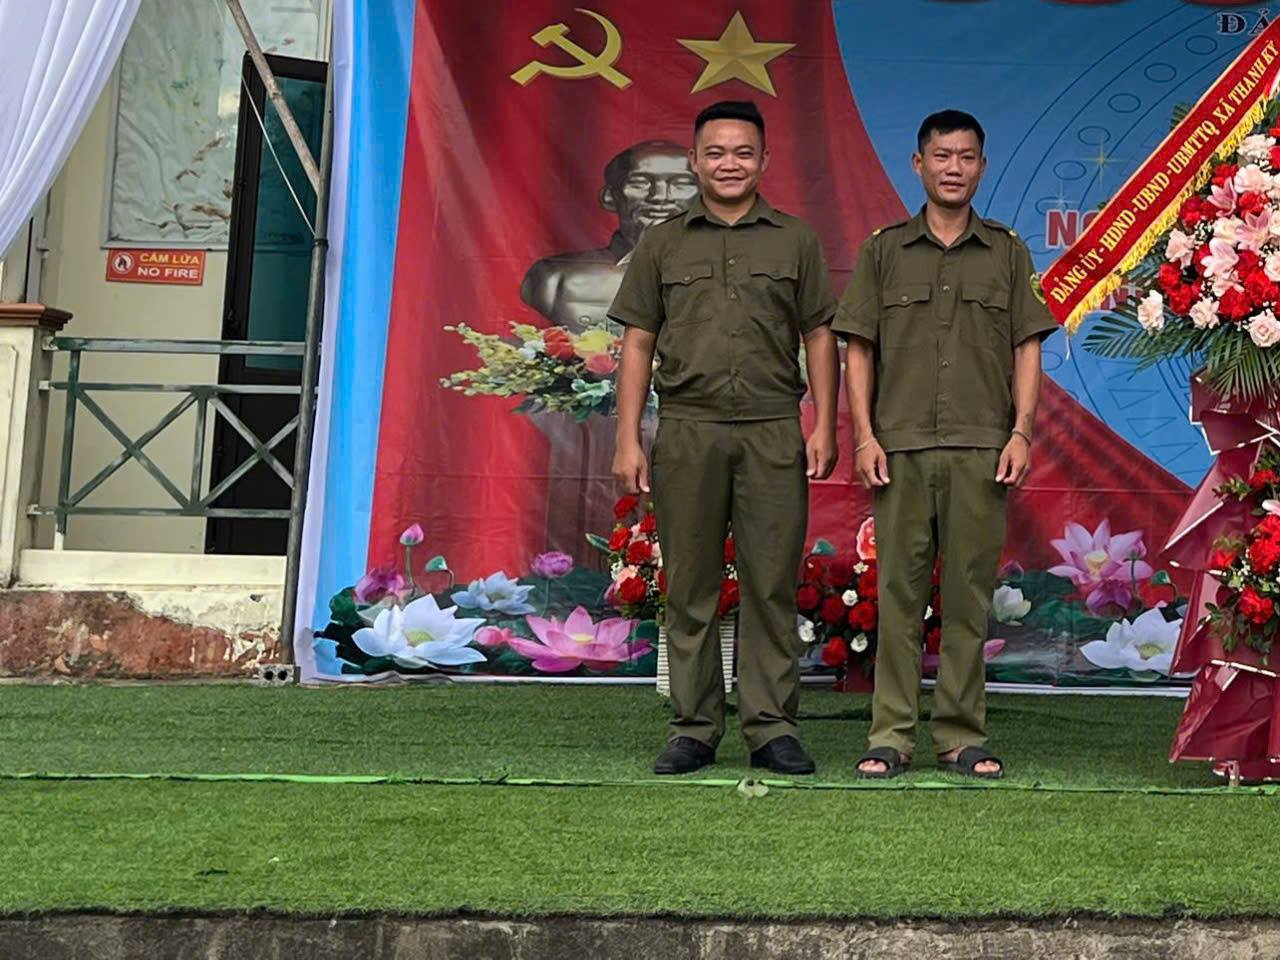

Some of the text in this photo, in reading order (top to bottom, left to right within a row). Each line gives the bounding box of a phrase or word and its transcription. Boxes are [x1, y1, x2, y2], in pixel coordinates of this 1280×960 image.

[1212, 97, 1236, 125] XÃ
[1228, 57, 1267, 105] THANH
[137, 267, 199, 279] NO FIRE
